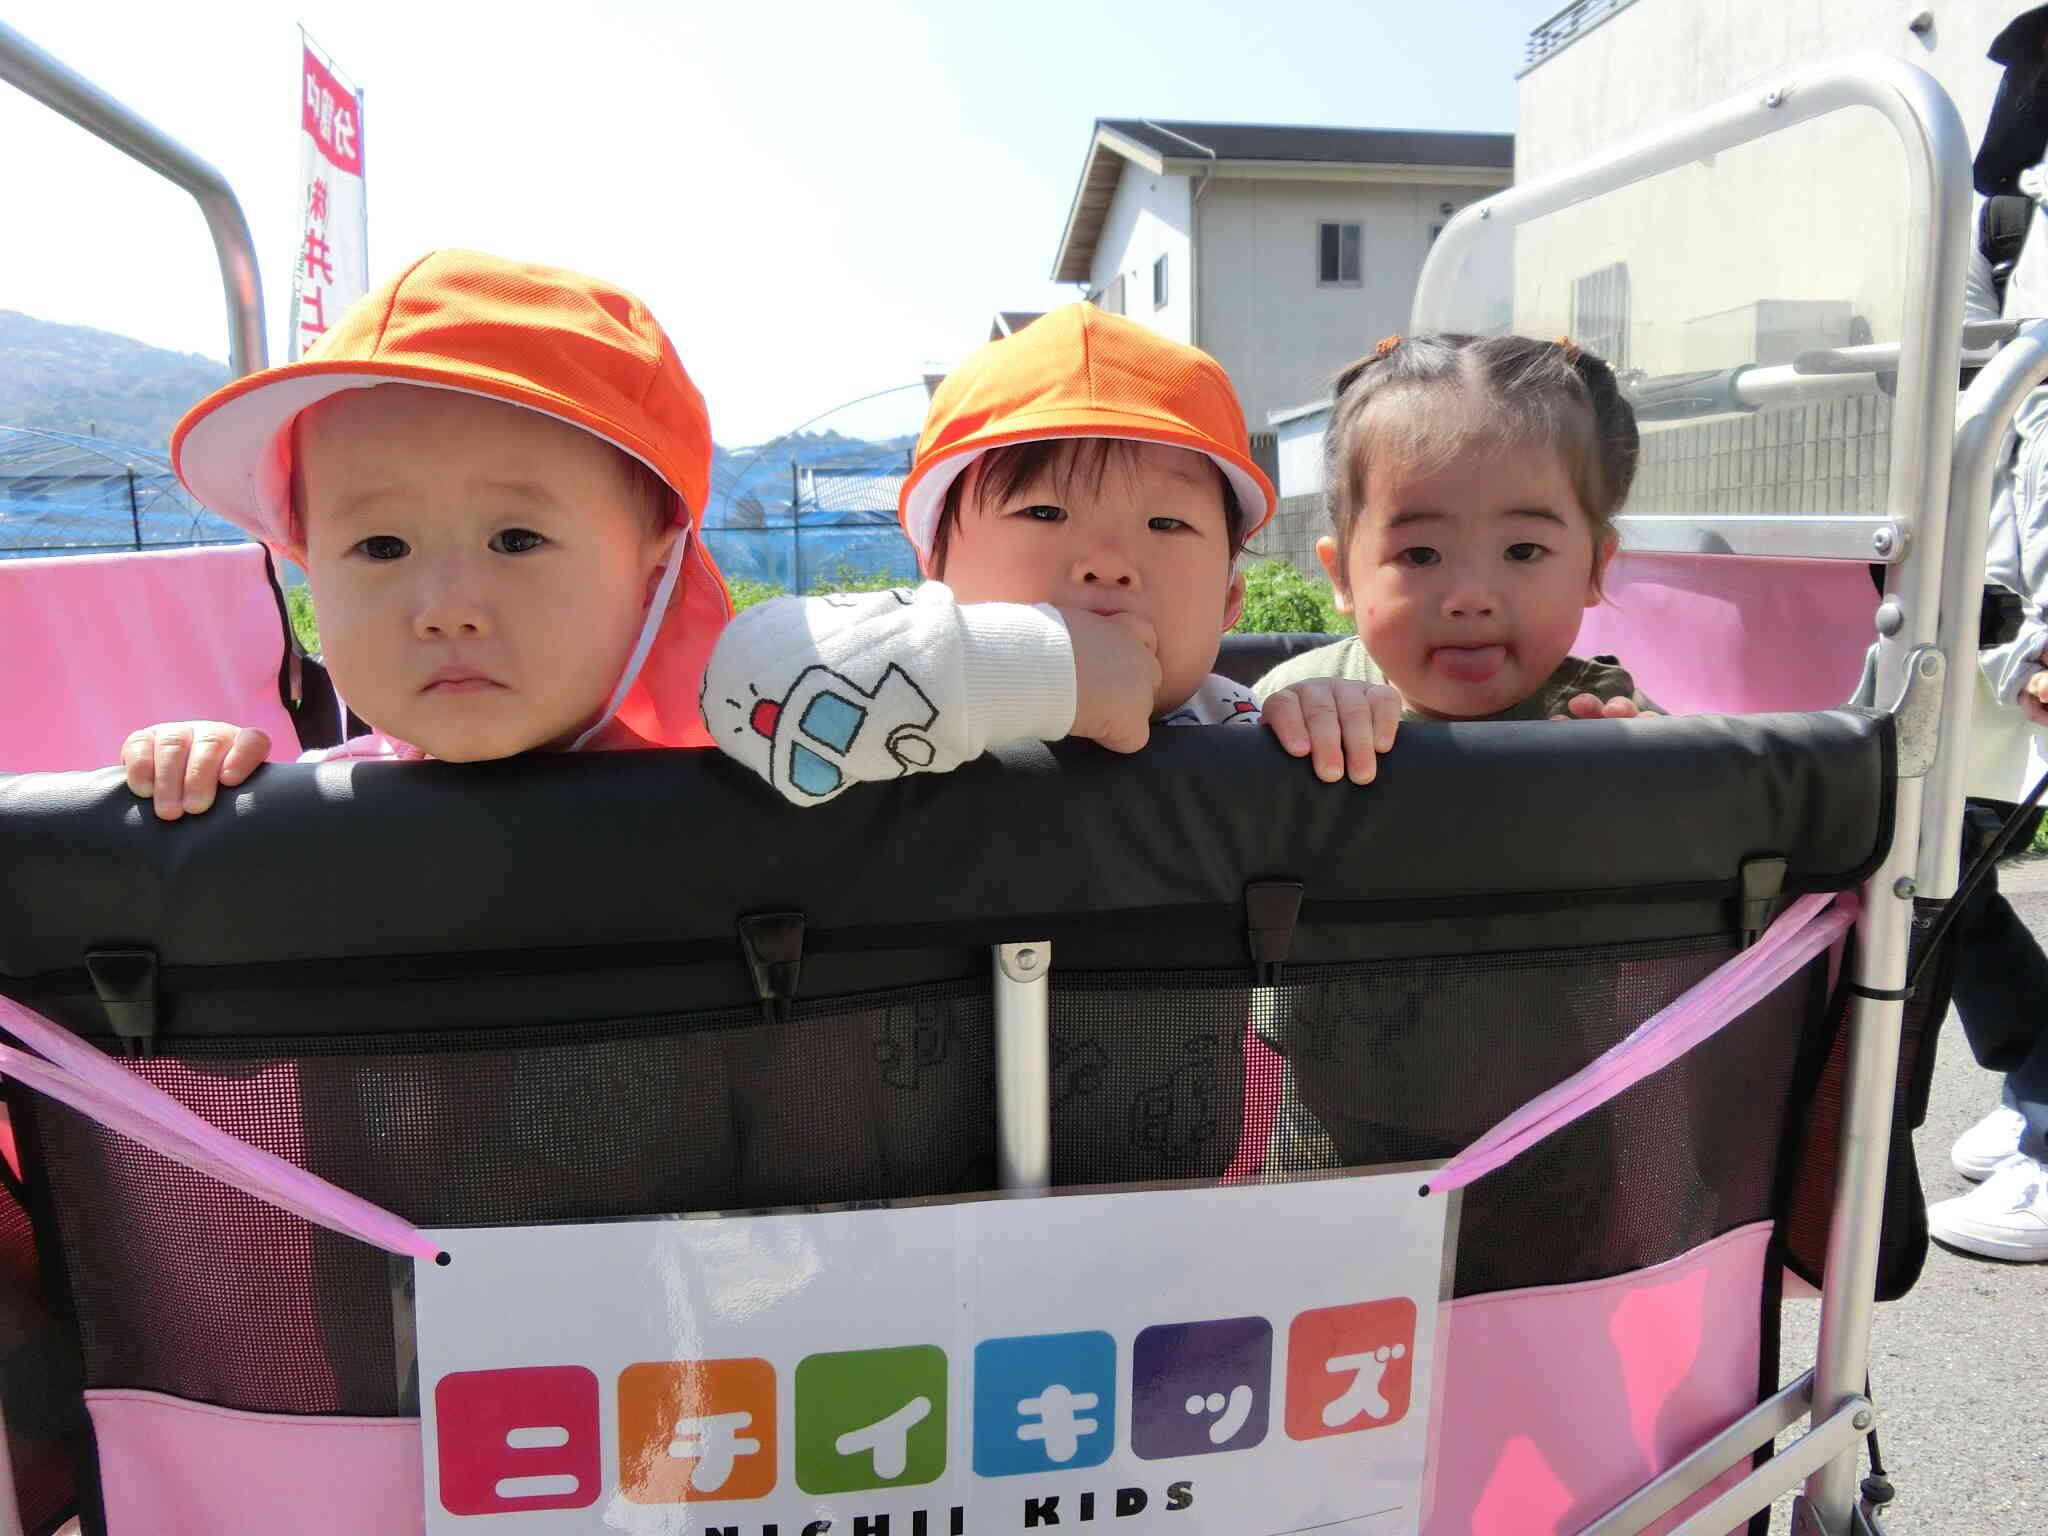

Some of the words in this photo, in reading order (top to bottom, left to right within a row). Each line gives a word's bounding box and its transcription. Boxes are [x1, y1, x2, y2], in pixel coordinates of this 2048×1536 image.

[495, 1343, 1405, 1498] ニチイキッズ
[1024, 1481, 1194, 1528] KIDS
